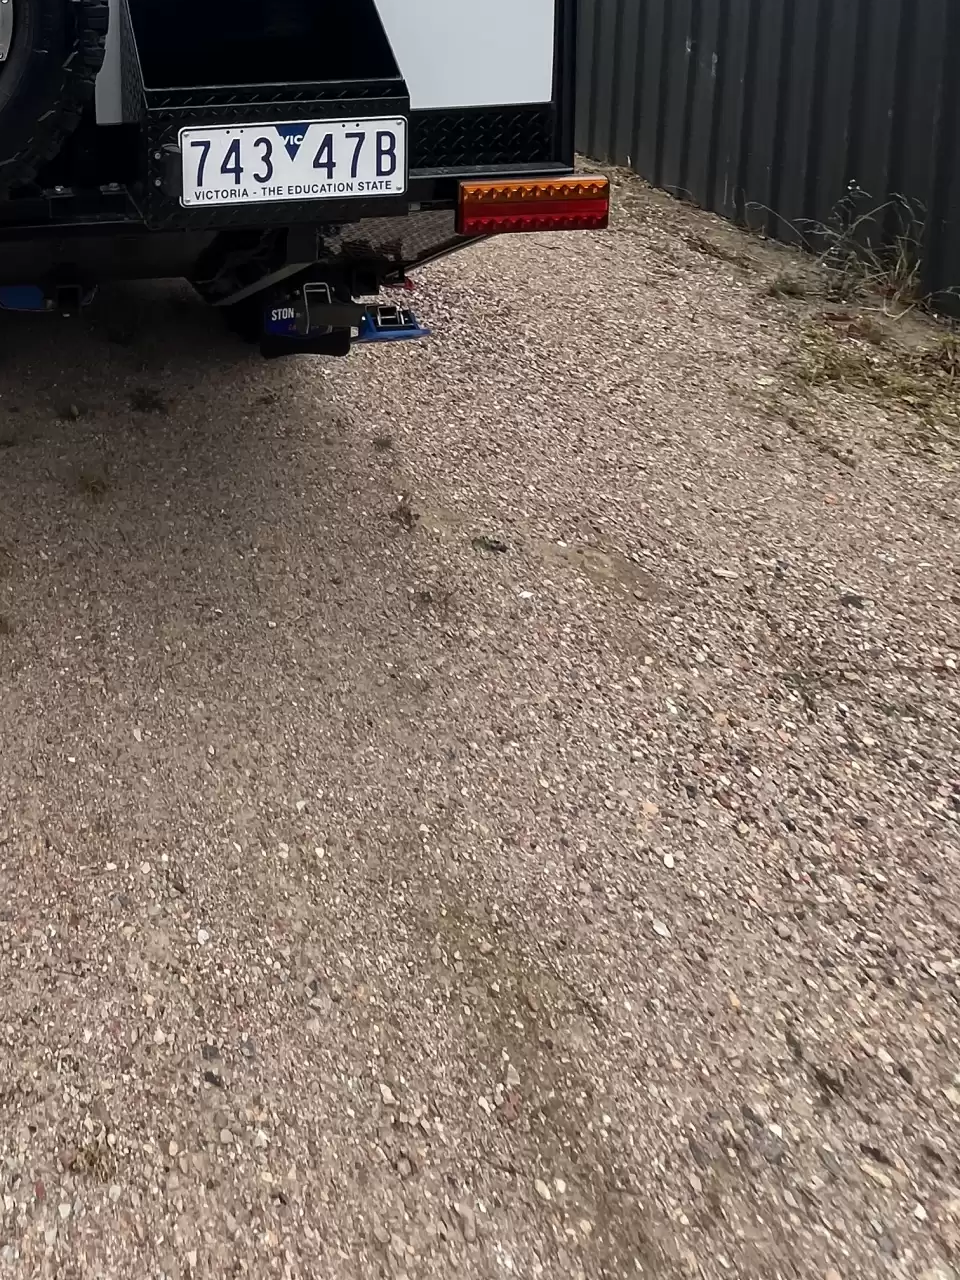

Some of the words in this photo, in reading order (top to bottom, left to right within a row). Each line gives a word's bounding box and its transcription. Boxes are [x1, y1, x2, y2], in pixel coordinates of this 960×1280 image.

[279, 134, 305, 145] VIC
[190, 136, 274, 187] 743
[312, 130, 397, 180] 47B
[194, 189, 250, 201] VICTORIA
[261, 186, 284, 197] THE
[286, 182, 354, 196] EDUCATION
[357, 180, 393, 192] STATE
